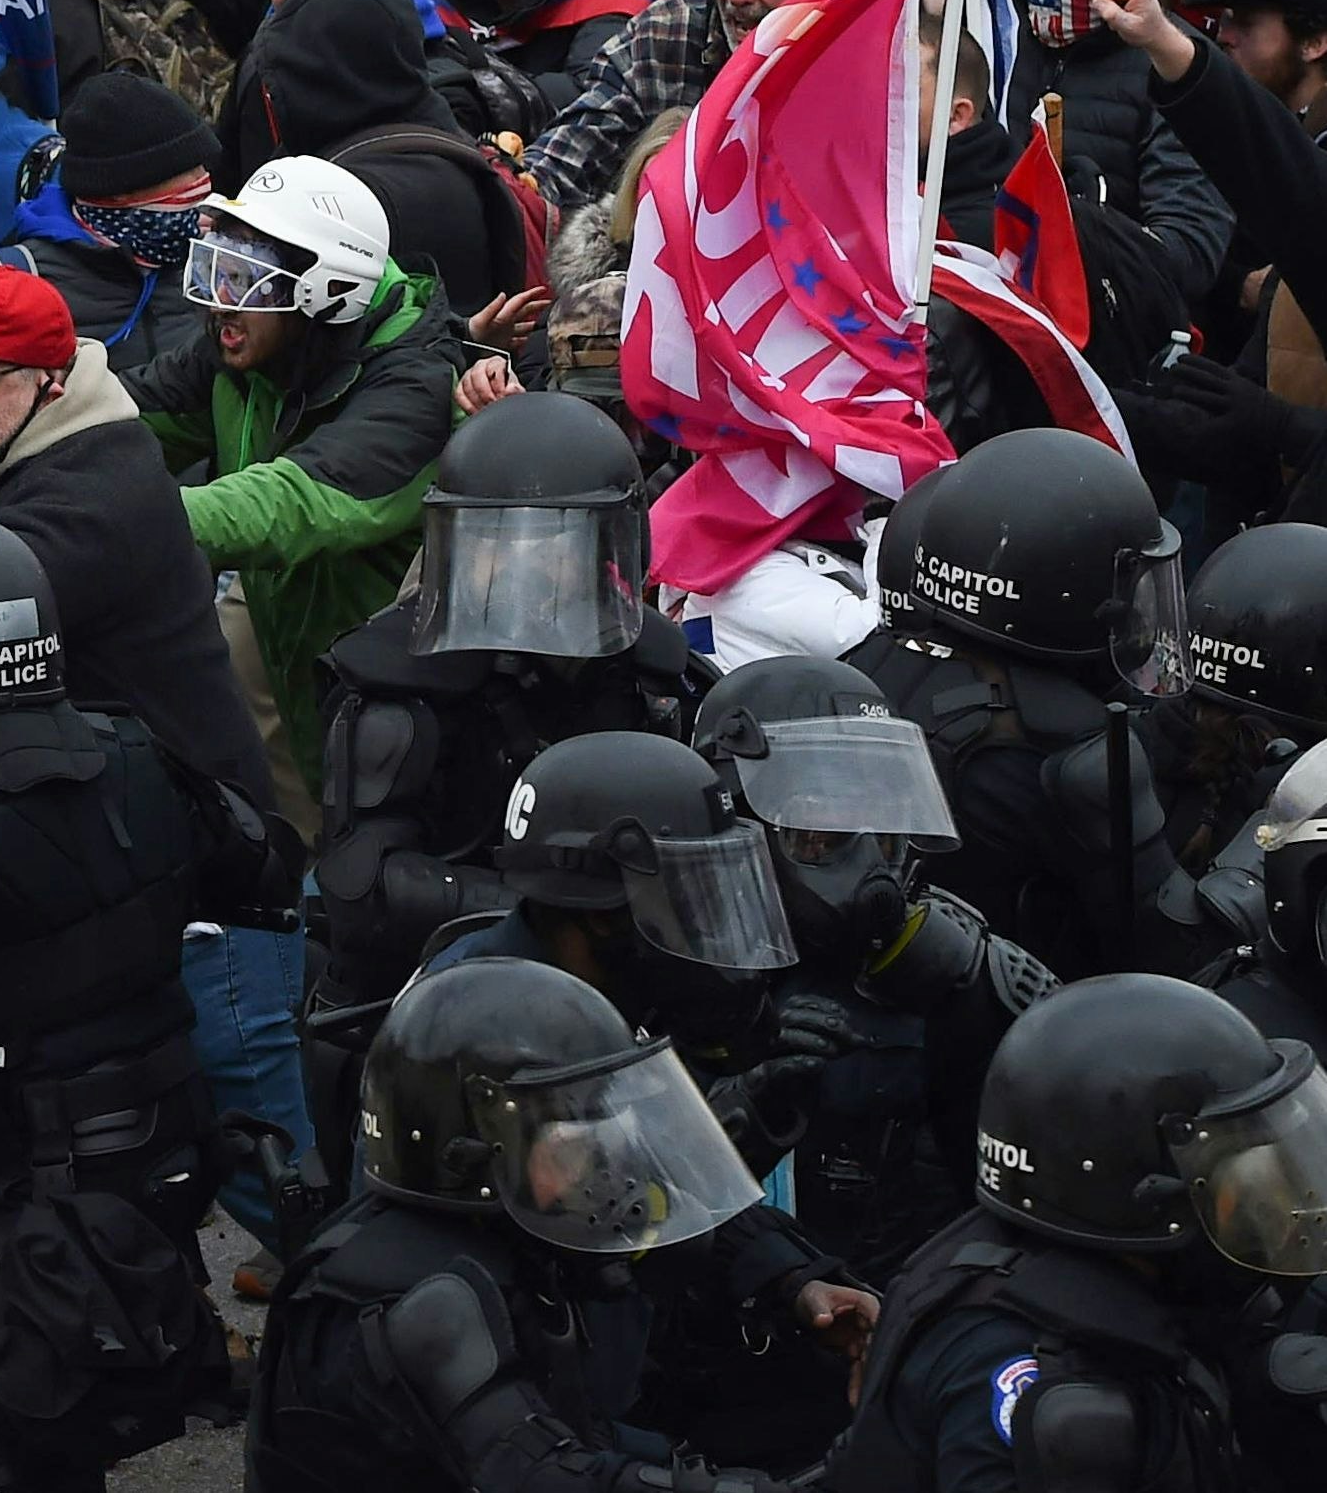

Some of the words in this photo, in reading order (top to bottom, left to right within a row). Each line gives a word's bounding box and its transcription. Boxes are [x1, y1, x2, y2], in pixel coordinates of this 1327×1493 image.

[915, 570, 981, 615] POLICE
[928, 556, 1021, 600] CAPITOL
[1187, 630, 1266, 670] APITOL
